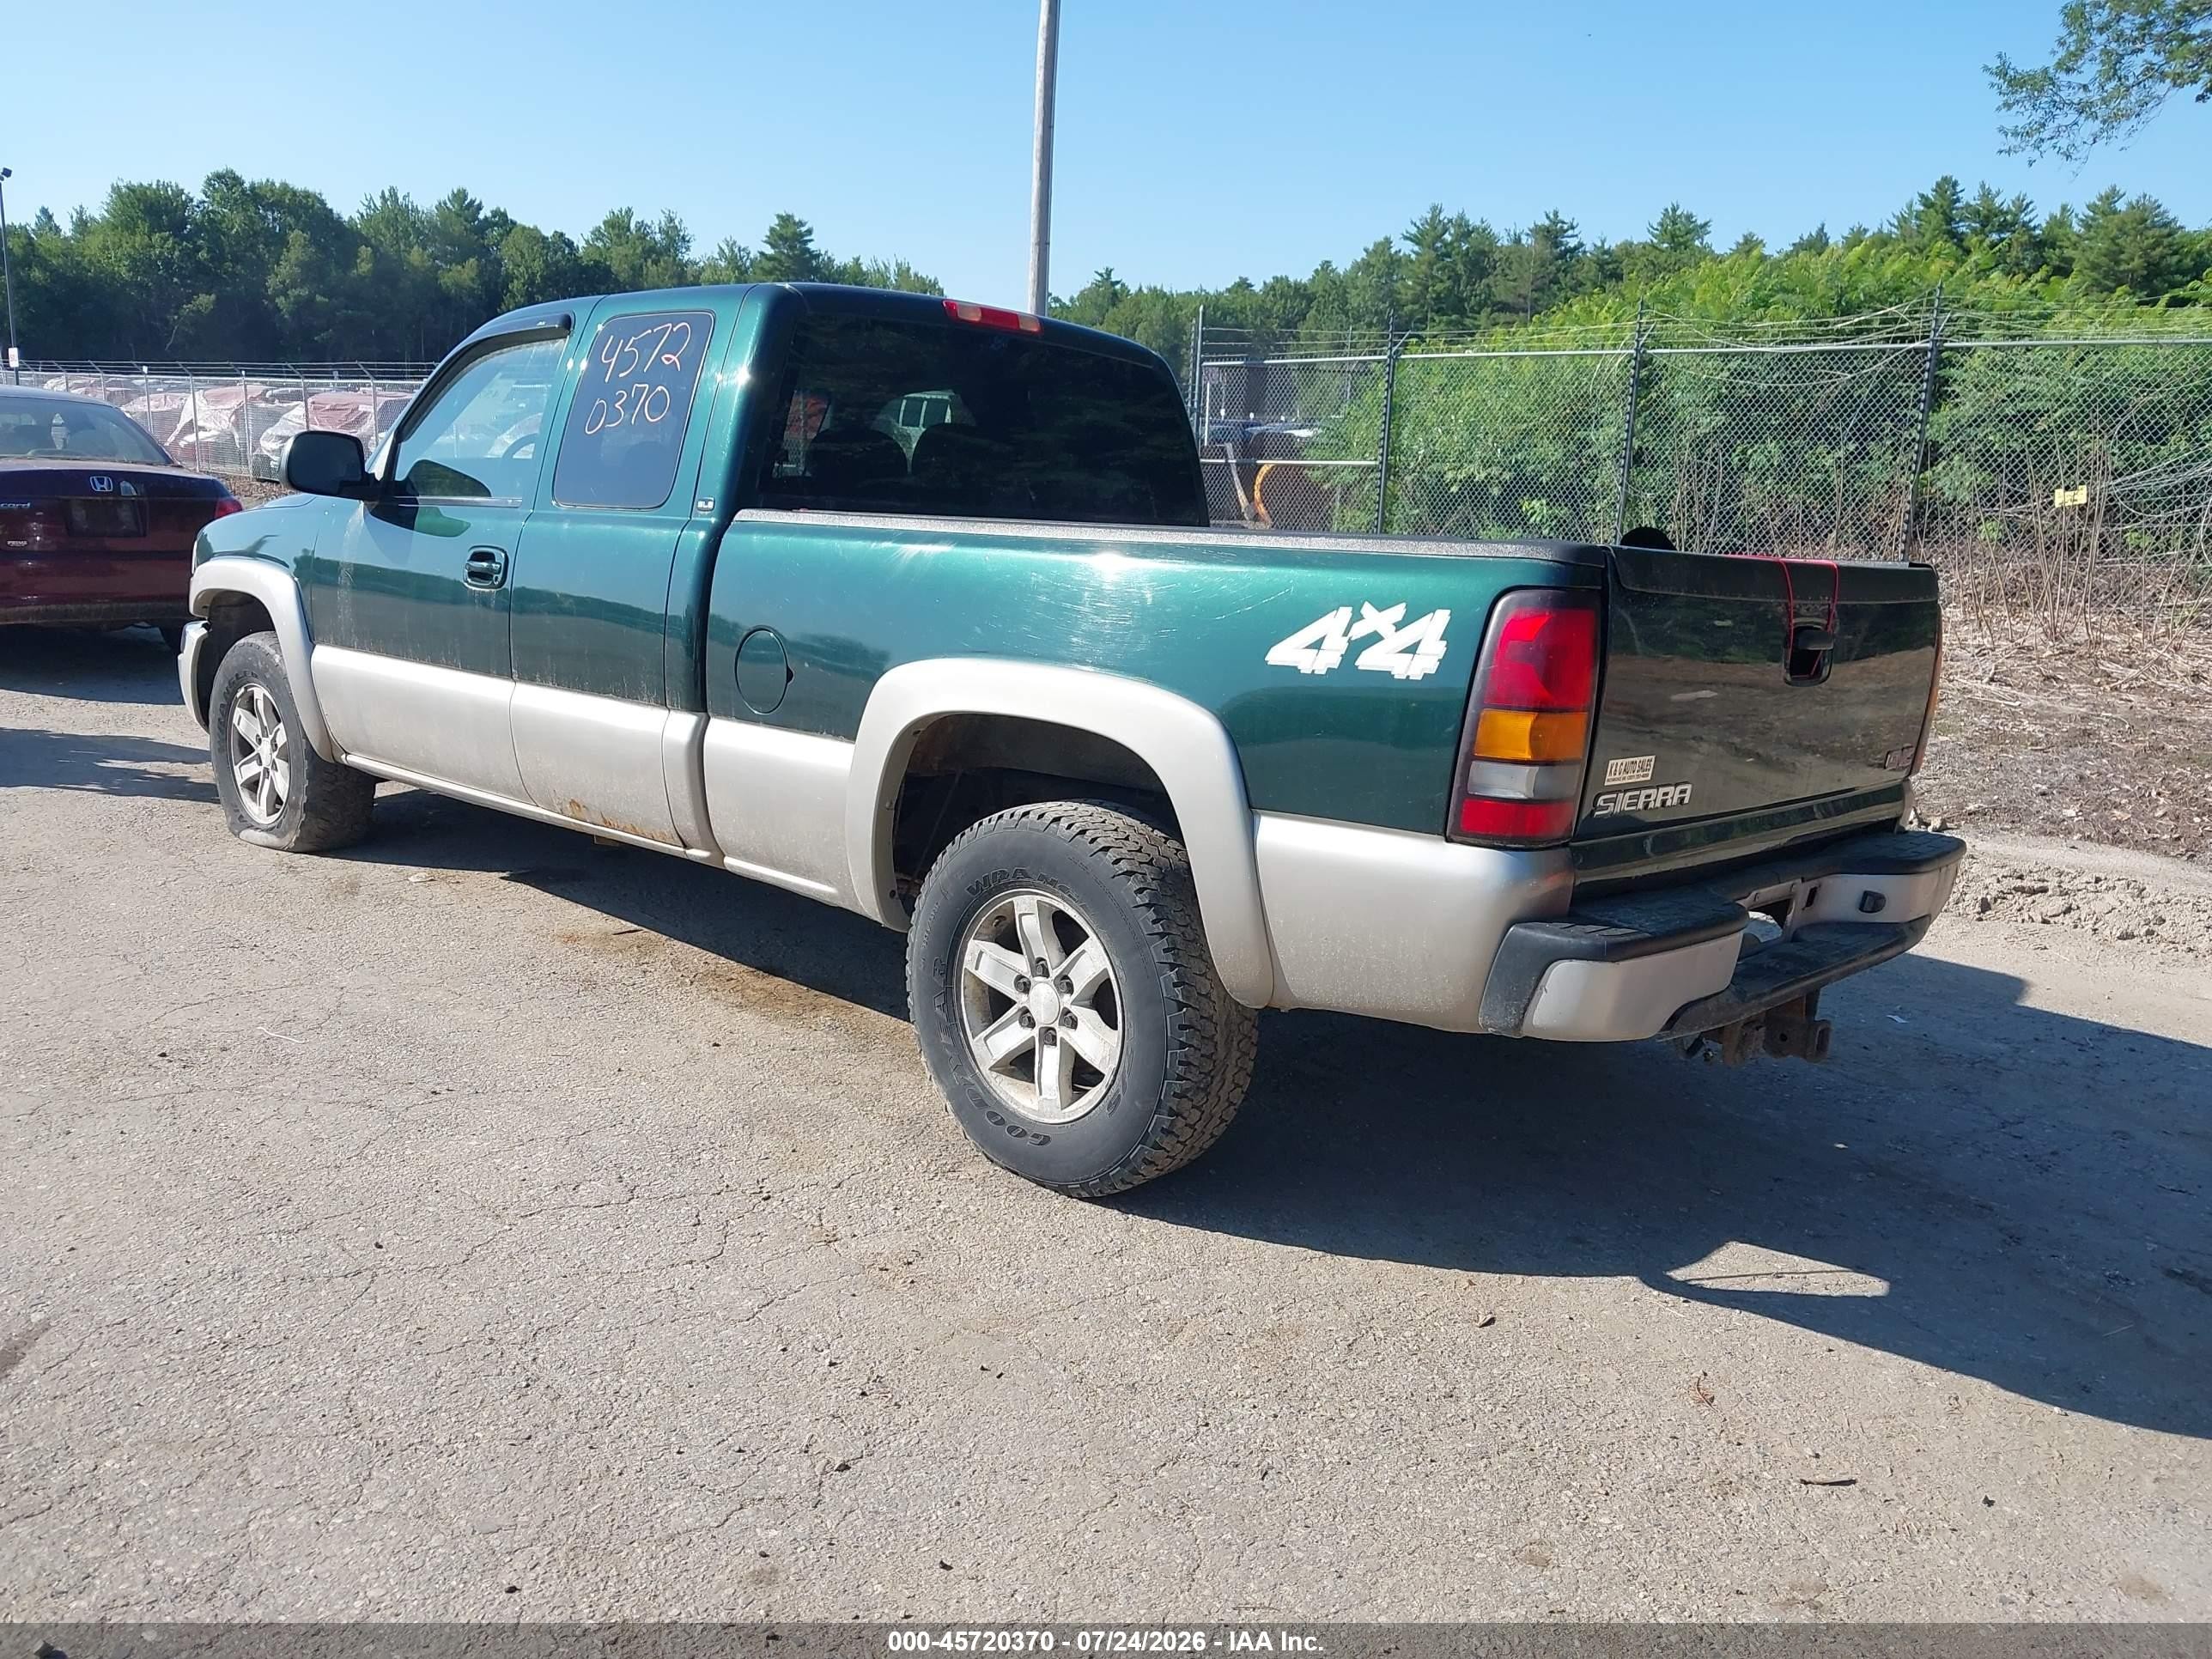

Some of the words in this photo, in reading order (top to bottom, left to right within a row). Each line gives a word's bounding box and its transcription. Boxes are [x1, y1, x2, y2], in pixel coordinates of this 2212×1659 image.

[601, 322, 691, 383] 4572
[585, 383, 671, 434] 0370
[1622, 760, 1638, 775] AUTO
[1636, 757, 1653, 774] SALES
[1593, 782, 1692, 818] SIERRA
